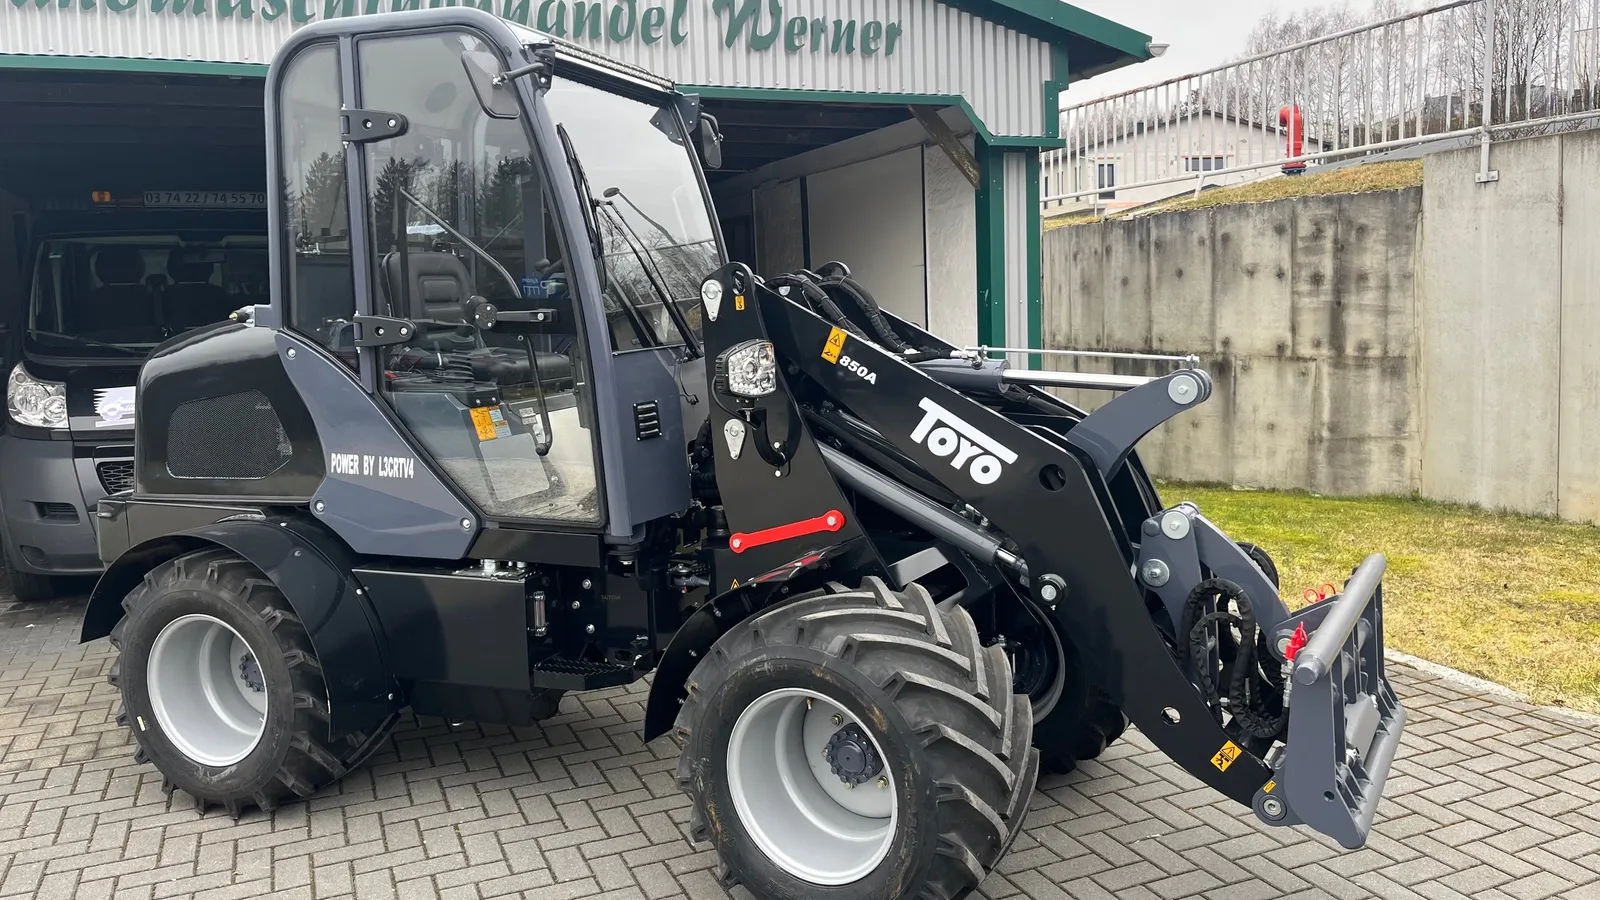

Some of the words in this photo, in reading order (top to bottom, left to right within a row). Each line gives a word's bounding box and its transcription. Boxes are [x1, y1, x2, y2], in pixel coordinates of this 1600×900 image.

[712, 0, 903, 57] Werner
[145, 192, 160, 203] 03
[165, 192, 180, 204] 74
[185, 192, 200, 204] 22
[212, 193, 227, 204] 74
[231, 194, 246, 204] 55
[251, 193, 265, 204] 70
[839, 355, 877, 385] 850A
[910, 396, 1019, 485] TOYO
[331, 453, 359, 475] POWER
[363, 455, 375, 476] BY
[378, 455, 414, 479] L3CRTV4
